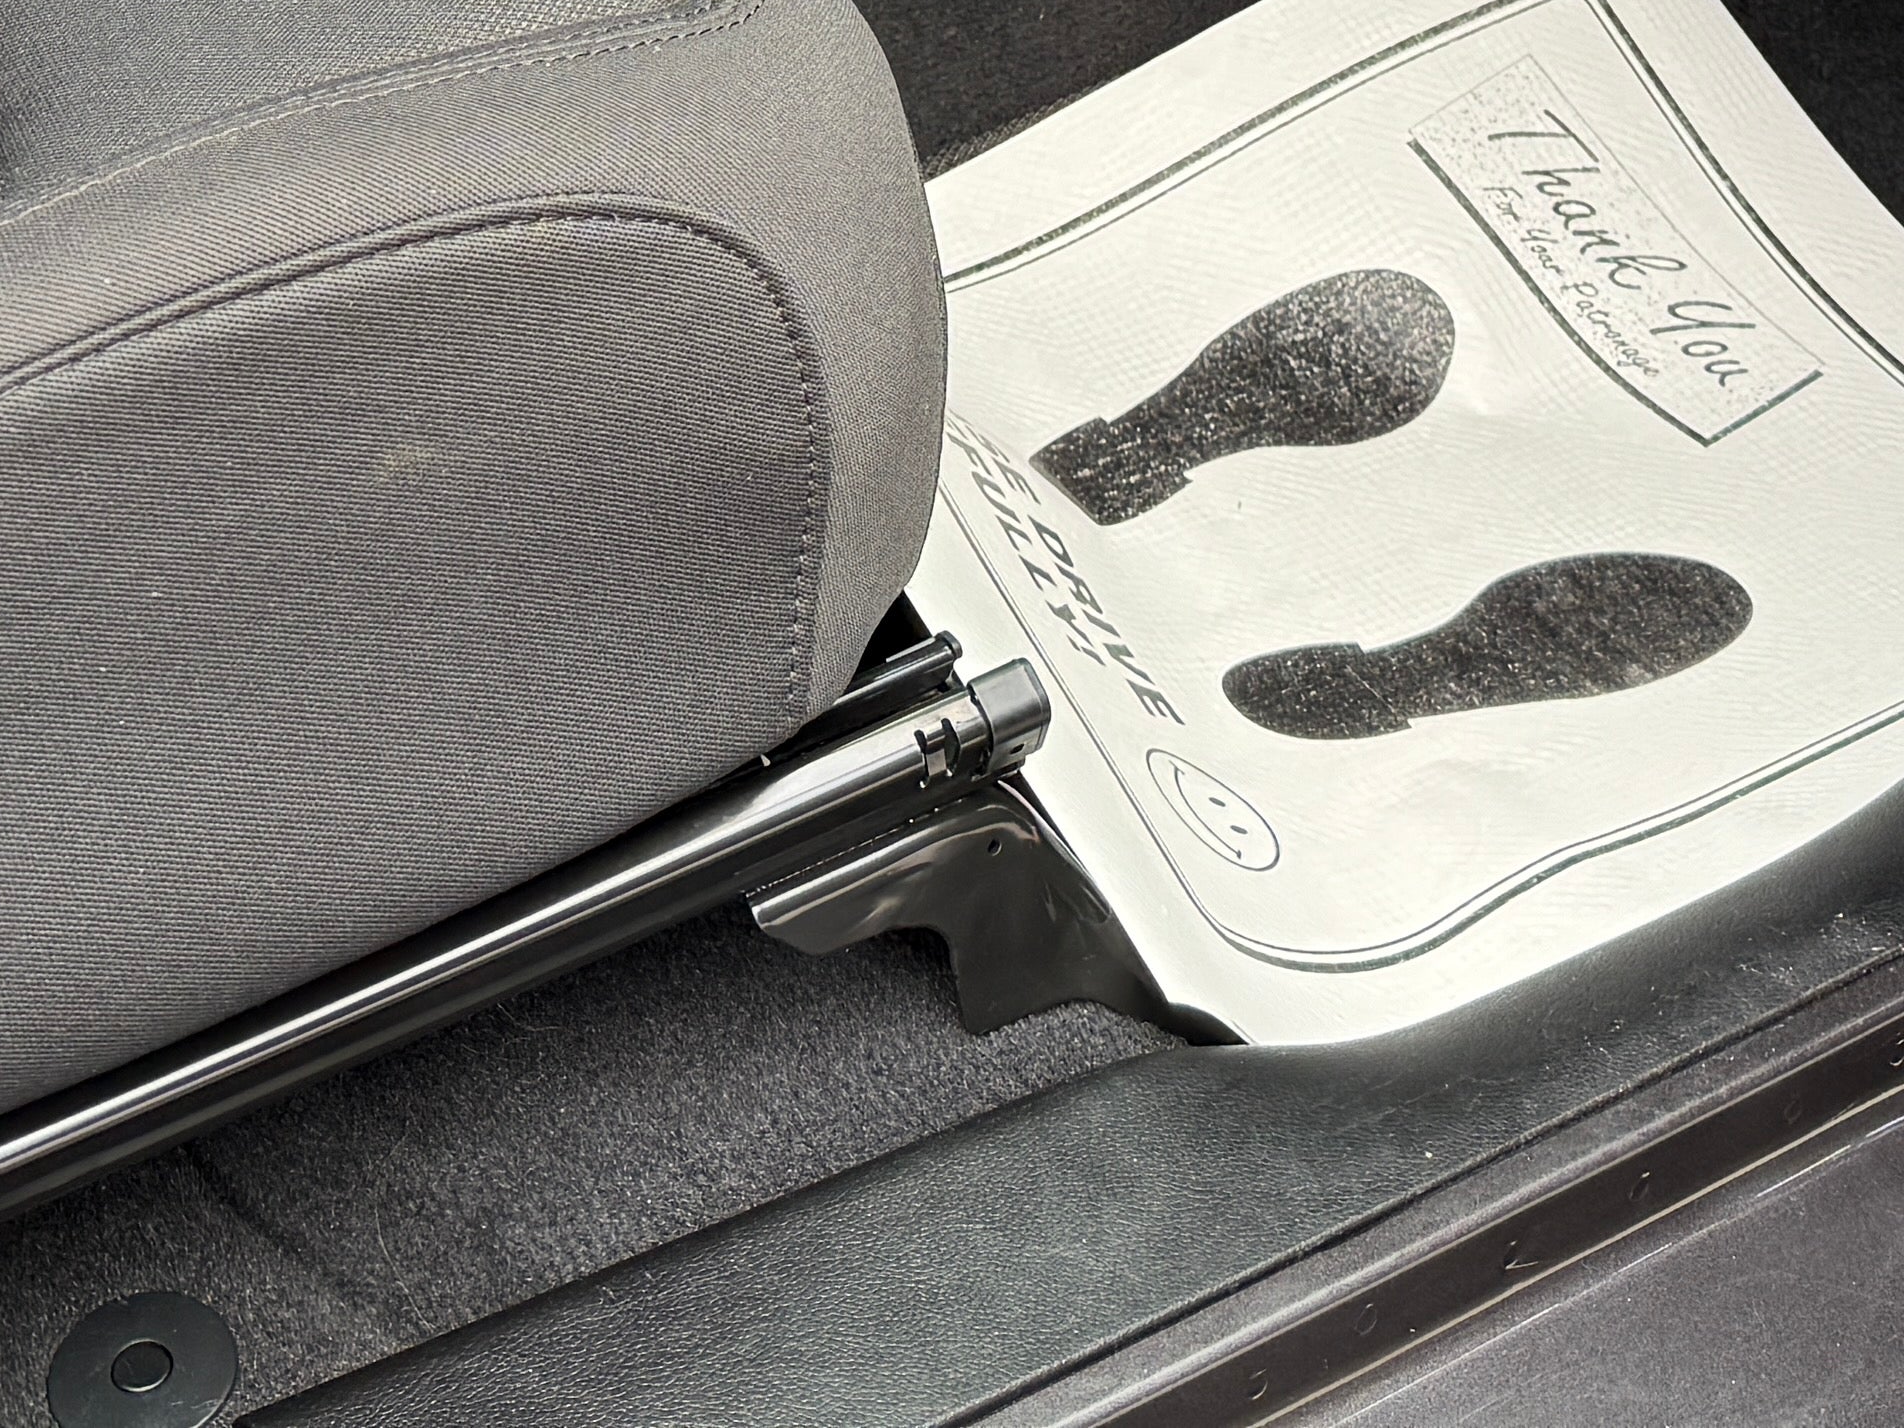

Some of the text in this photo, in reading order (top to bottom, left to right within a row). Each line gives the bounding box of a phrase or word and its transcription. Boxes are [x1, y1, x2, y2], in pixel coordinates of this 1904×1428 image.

[1487, 109, 1757, 387] Thank You
[946, 418, 1107, 667] FULLY!
[1027, 514, 1186, 726] DRIVE
